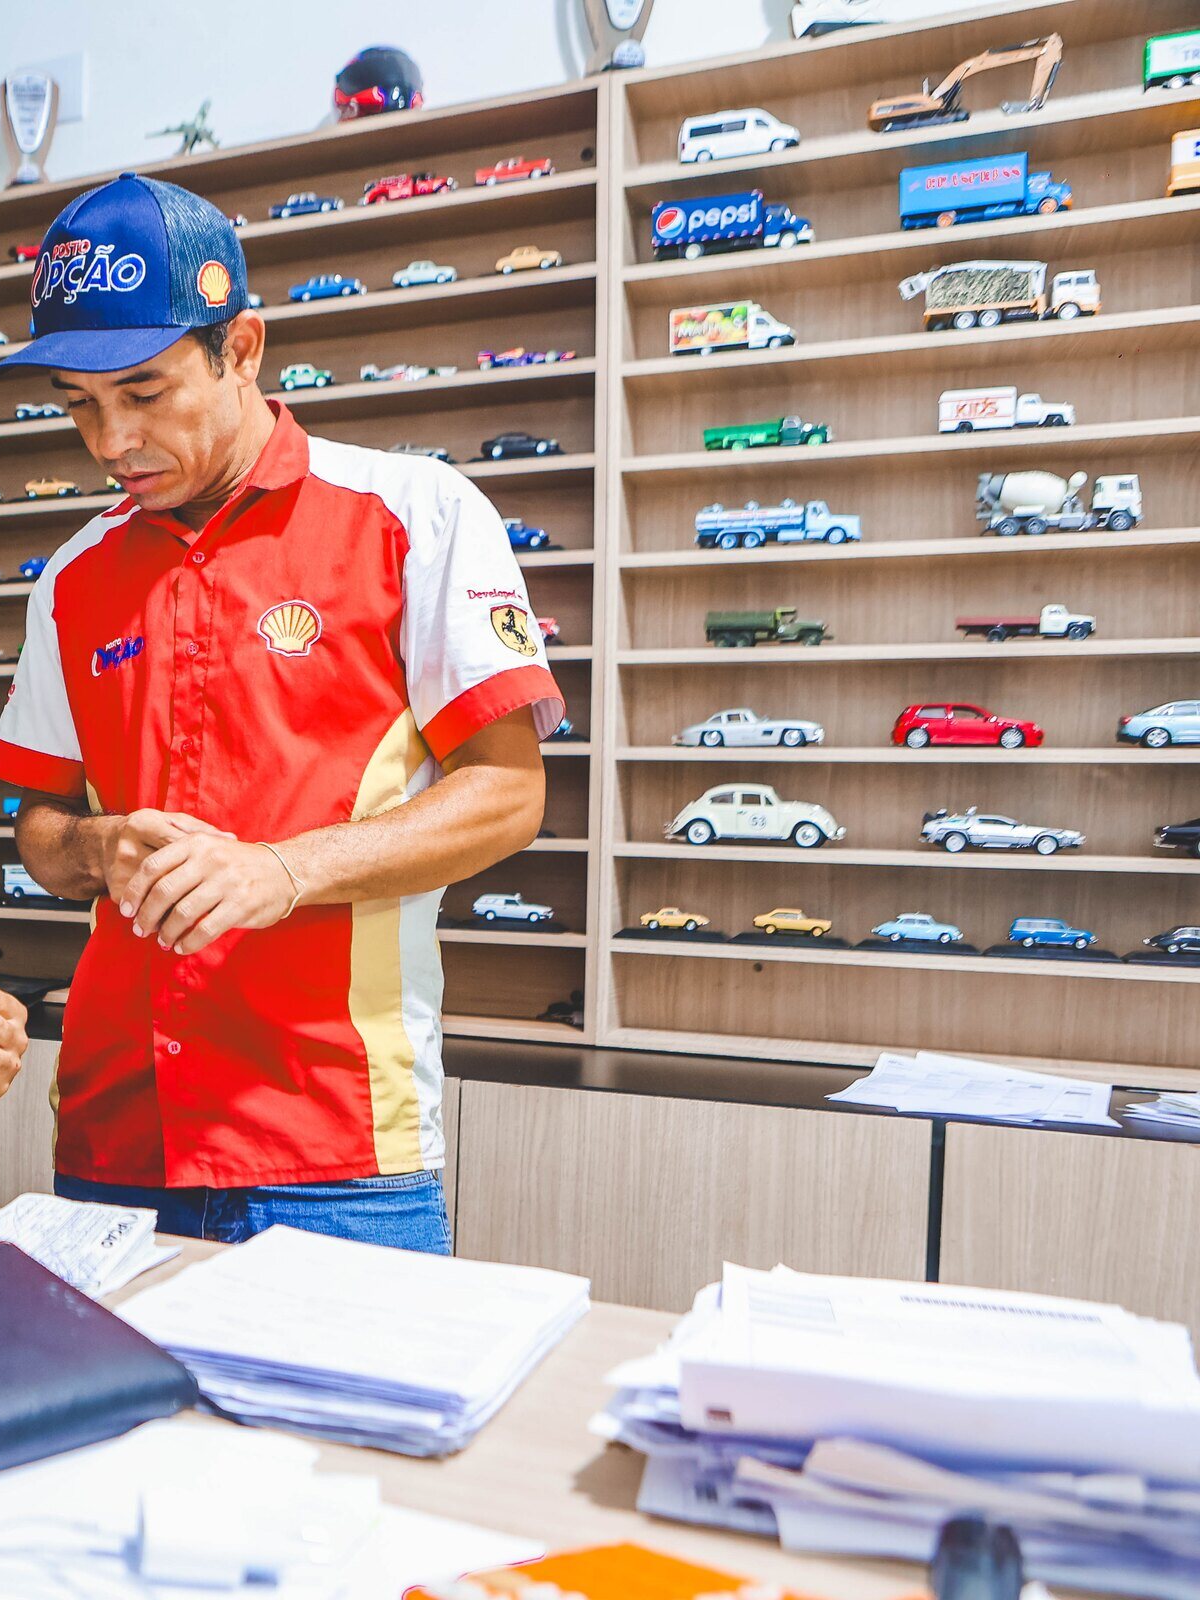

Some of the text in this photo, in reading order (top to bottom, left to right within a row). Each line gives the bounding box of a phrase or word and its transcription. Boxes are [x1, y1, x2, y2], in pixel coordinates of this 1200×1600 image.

[687, 200, 757, 234] pepsi
[52, 239, 91, 261] POSTO
[31, 245, 146, 307] OPÇÃO
